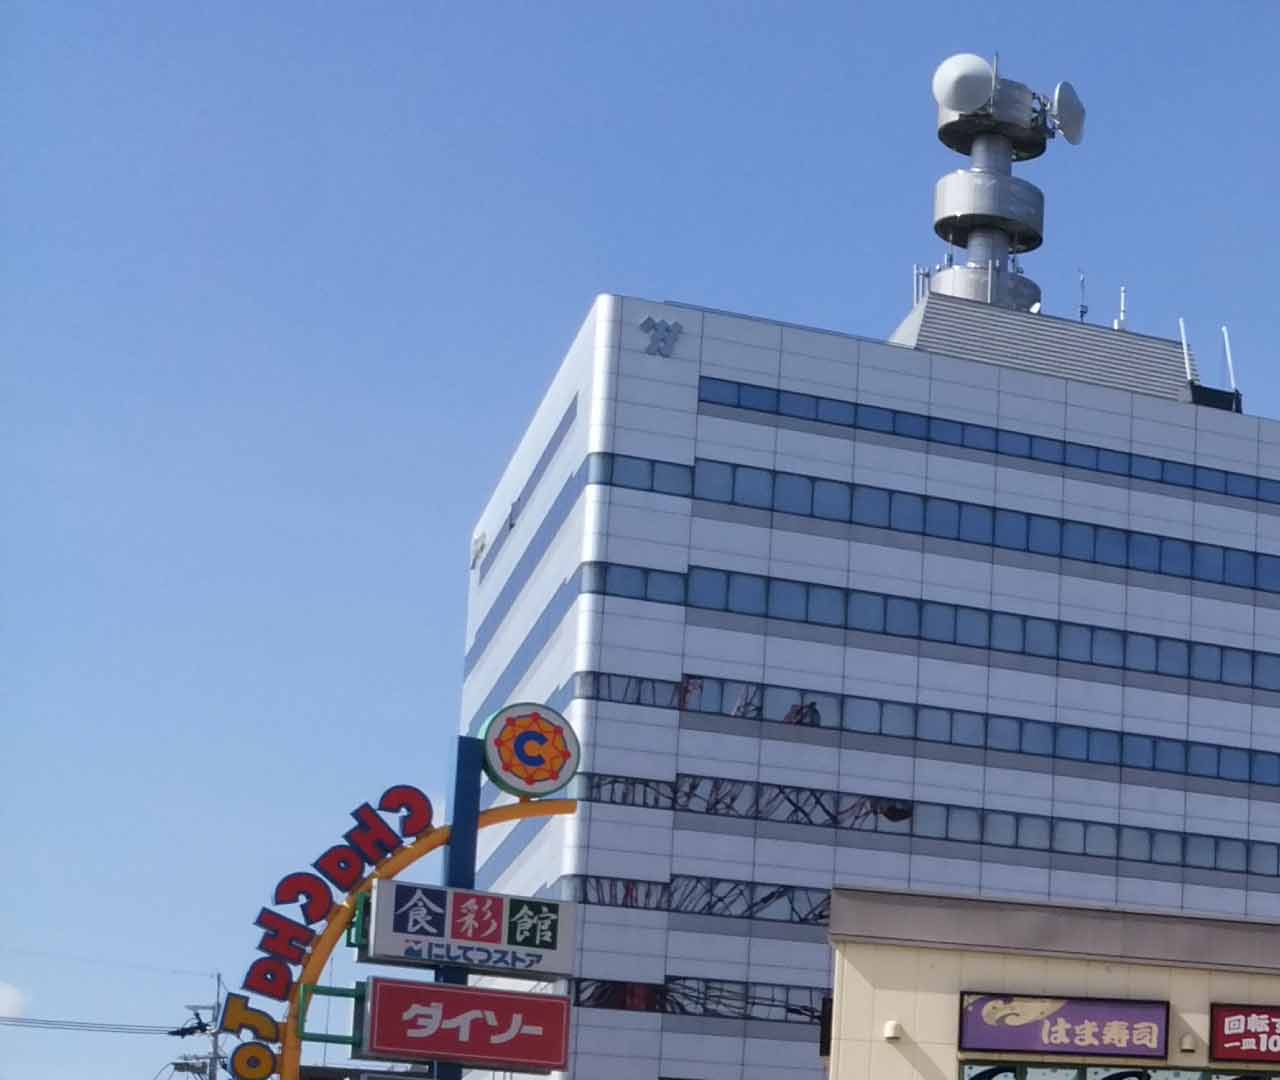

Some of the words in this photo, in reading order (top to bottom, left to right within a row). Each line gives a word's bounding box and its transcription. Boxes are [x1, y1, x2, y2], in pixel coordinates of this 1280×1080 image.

[395, 889, 558, 944] 食彩館
[427, 942, 543, 968] にしてつストア
[402, 1002, 543, 1044] ダイソー
[1040, 1019, 1160, 1050] はま寿司
